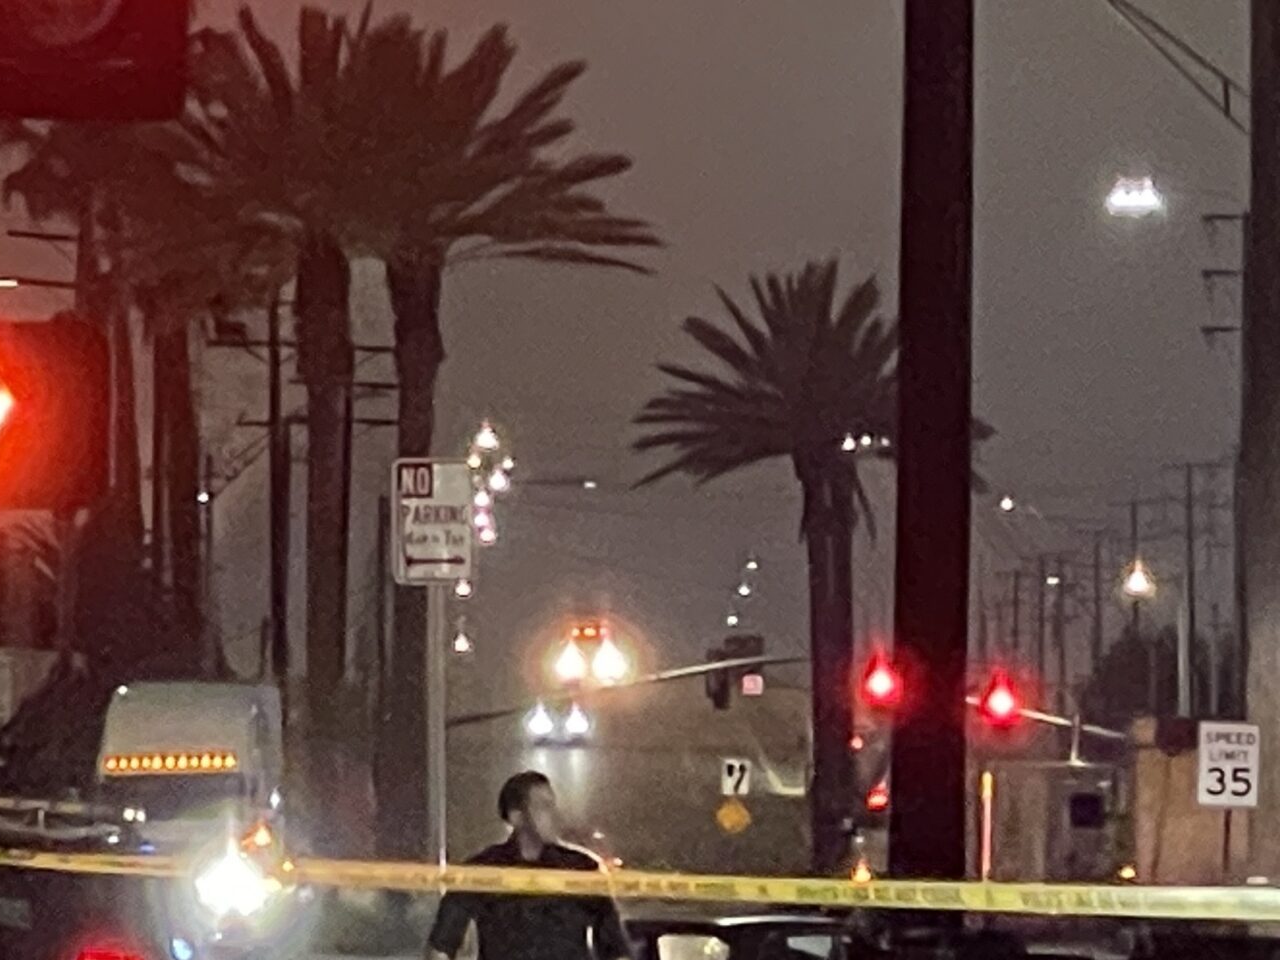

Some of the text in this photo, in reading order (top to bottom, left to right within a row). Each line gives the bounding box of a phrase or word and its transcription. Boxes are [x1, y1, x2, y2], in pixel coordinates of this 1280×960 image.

[400, 466, 430, 496] NO
[400, 503, 467, 524] PARKING
[1206, 731, 1256, 746] SPEED
[1210, 750, 1248, 762] LIMIT
[1206, 766, 1252, 797] 35
